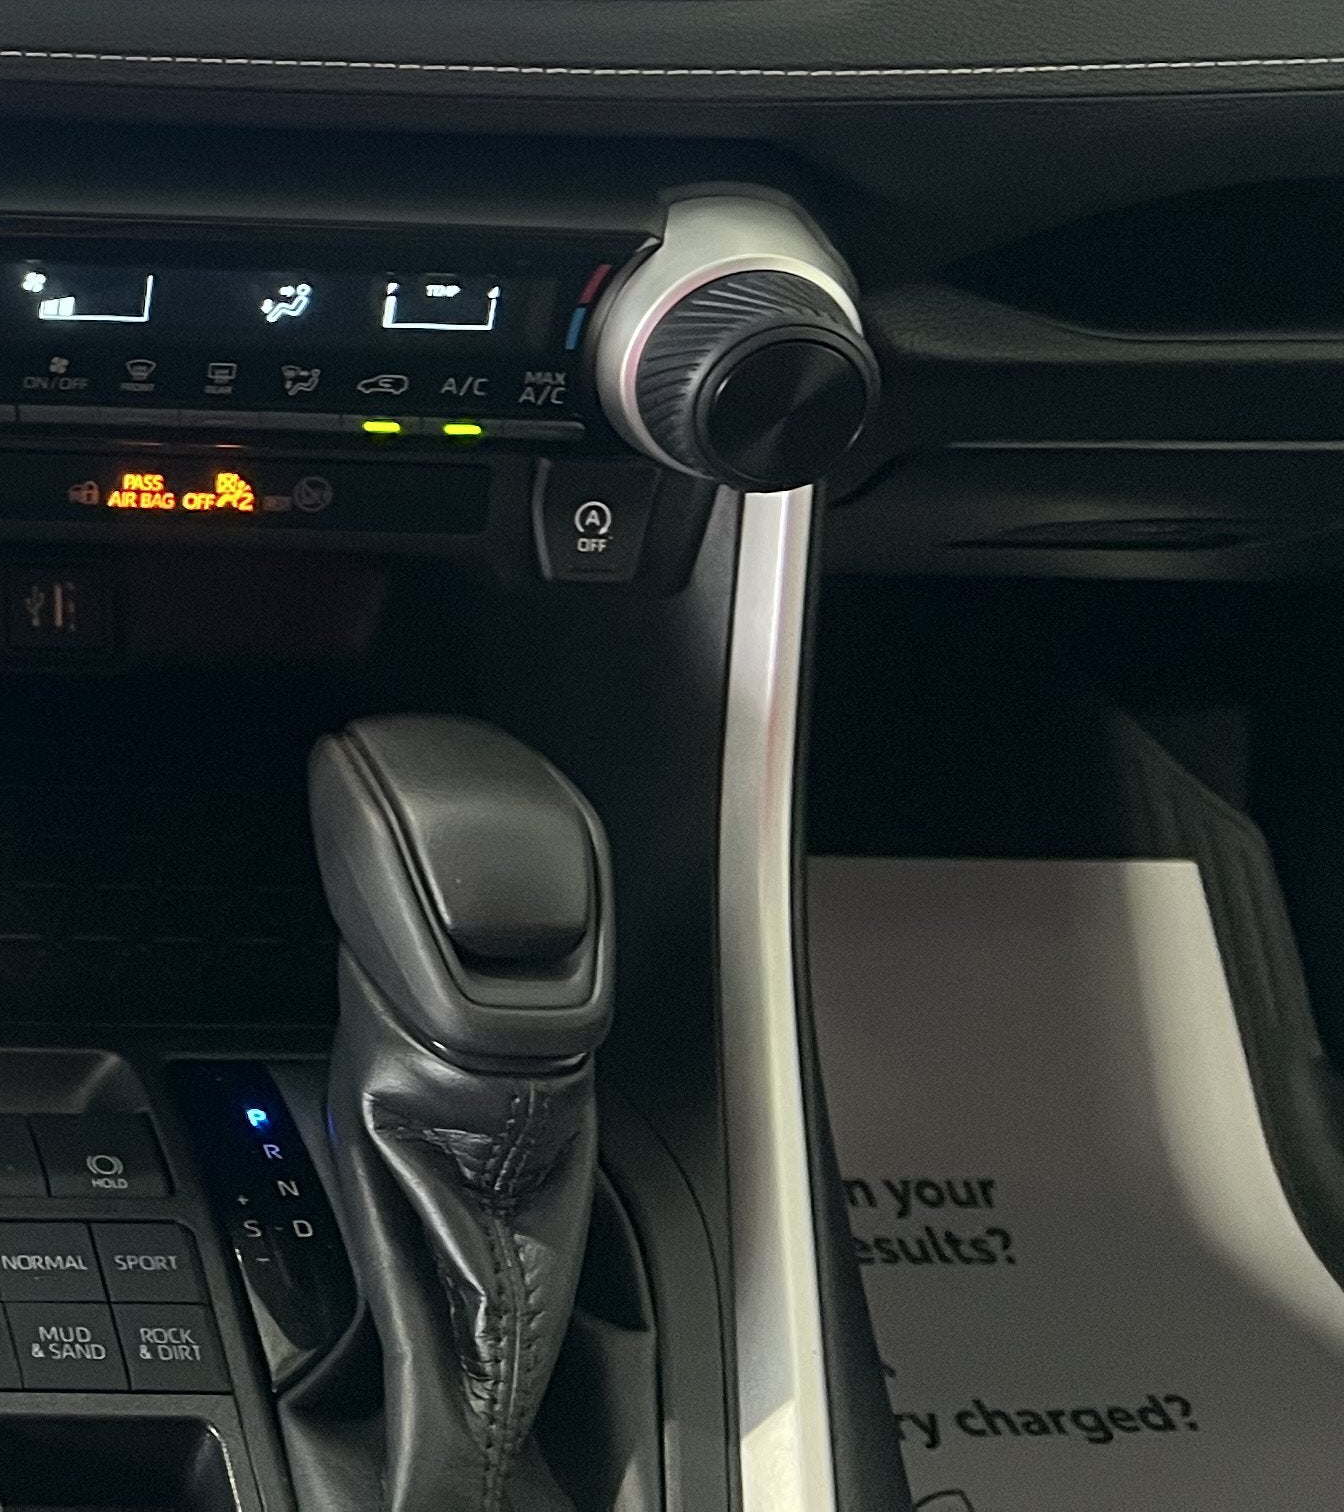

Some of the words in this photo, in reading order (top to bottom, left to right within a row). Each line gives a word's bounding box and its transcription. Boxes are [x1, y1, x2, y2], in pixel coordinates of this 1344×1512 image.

[440, 376, 489, 396] A/C
[524, 371, 567, 385] MAX
[518, 386, 566, 405] A/C
[123, 473, 164, 491] PASS
[107, 491, 137, 508] AIR
[140, 492, 175, 510] BAG
[182, 492, 216, 511] OFF
[577, 538, 607, 552] OFF
[247, 1108, 267, 1127] P
[263, 1144, 283, 1160] R
[92, 1178, 128, 1189] HOLD
[277, 1180, 300, 1196] N
[882, 1178, 995, 1219] your
[243, 1219, 262, 1238] S
[292, 1219, 313, 1238] D
[1, 1254, 88, 1271] NORMAL
[114, 1255, 178, 1272] SPORT
[39, 1326, 92, 1343] MUD
[139, 1327, 196, 1344] ROCK
[31, 1343, 45, 1358] &
[48, 1343, 106, 1360] SAND
[139, 1344, 152, 1360] &
[158, 1345, 201, 1361] DIRT
[955, 1393, 1199, 1445] charged?
